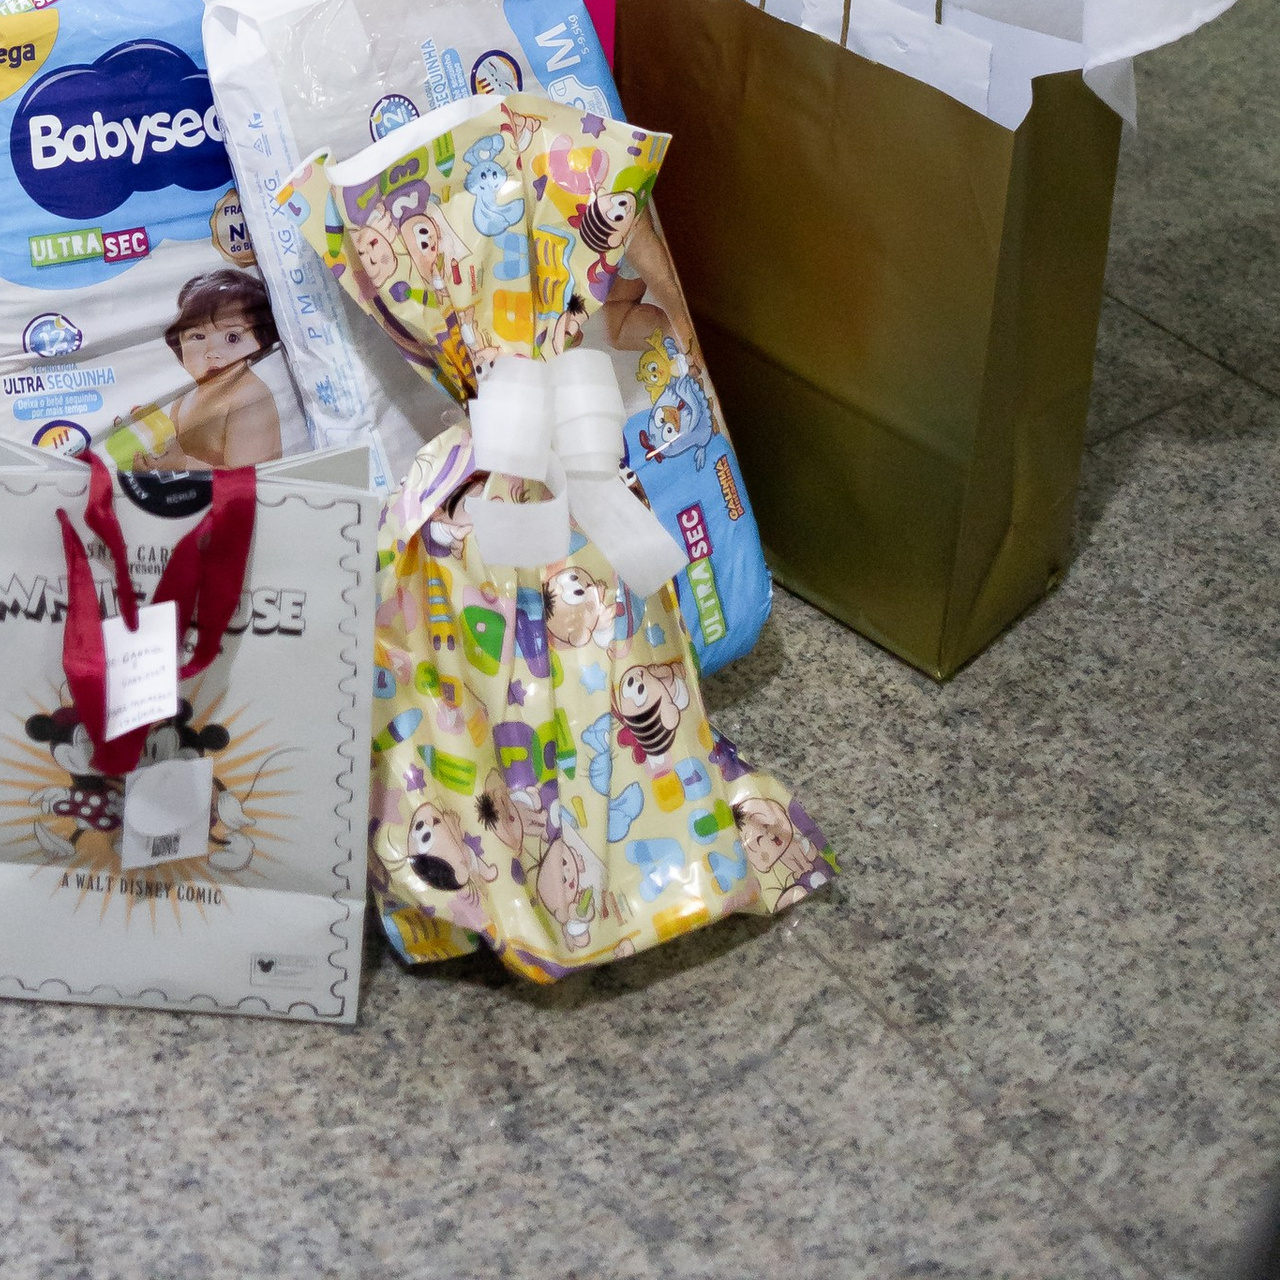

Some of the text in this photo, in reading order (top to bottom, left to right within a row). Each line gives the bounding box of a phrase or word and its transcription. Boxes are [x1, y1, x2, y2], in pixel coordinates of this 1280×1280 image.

[534, 22, 582, 72] M
[568, 14, 589, 55] 5-9,5kg
[421, 38, 450, 103] EQUINHA
[424, 78, 437, 108] OLOGIA
[224, 204, 243, 217] FRA
[31, 229, 148, 262] ULTRA SEC
[229, 222, 246, 242] N
[282, 228, 295, 256] XG
[231, 244, 241, 253] do
[291, 269, 305, 285] G
[301, 295, 313, 316] M
[310, 326, 322, 339] P
[4, 368, 116, 395] ULTRA SEQUINHA
[31, 403, 88, 419] por mais tempo
[65, 393, 98, 405] sequinho
[682, 507, 723, 643] ULTRA SEC
[61, 872, 222, 905] A WALT DISNEY COMIC
